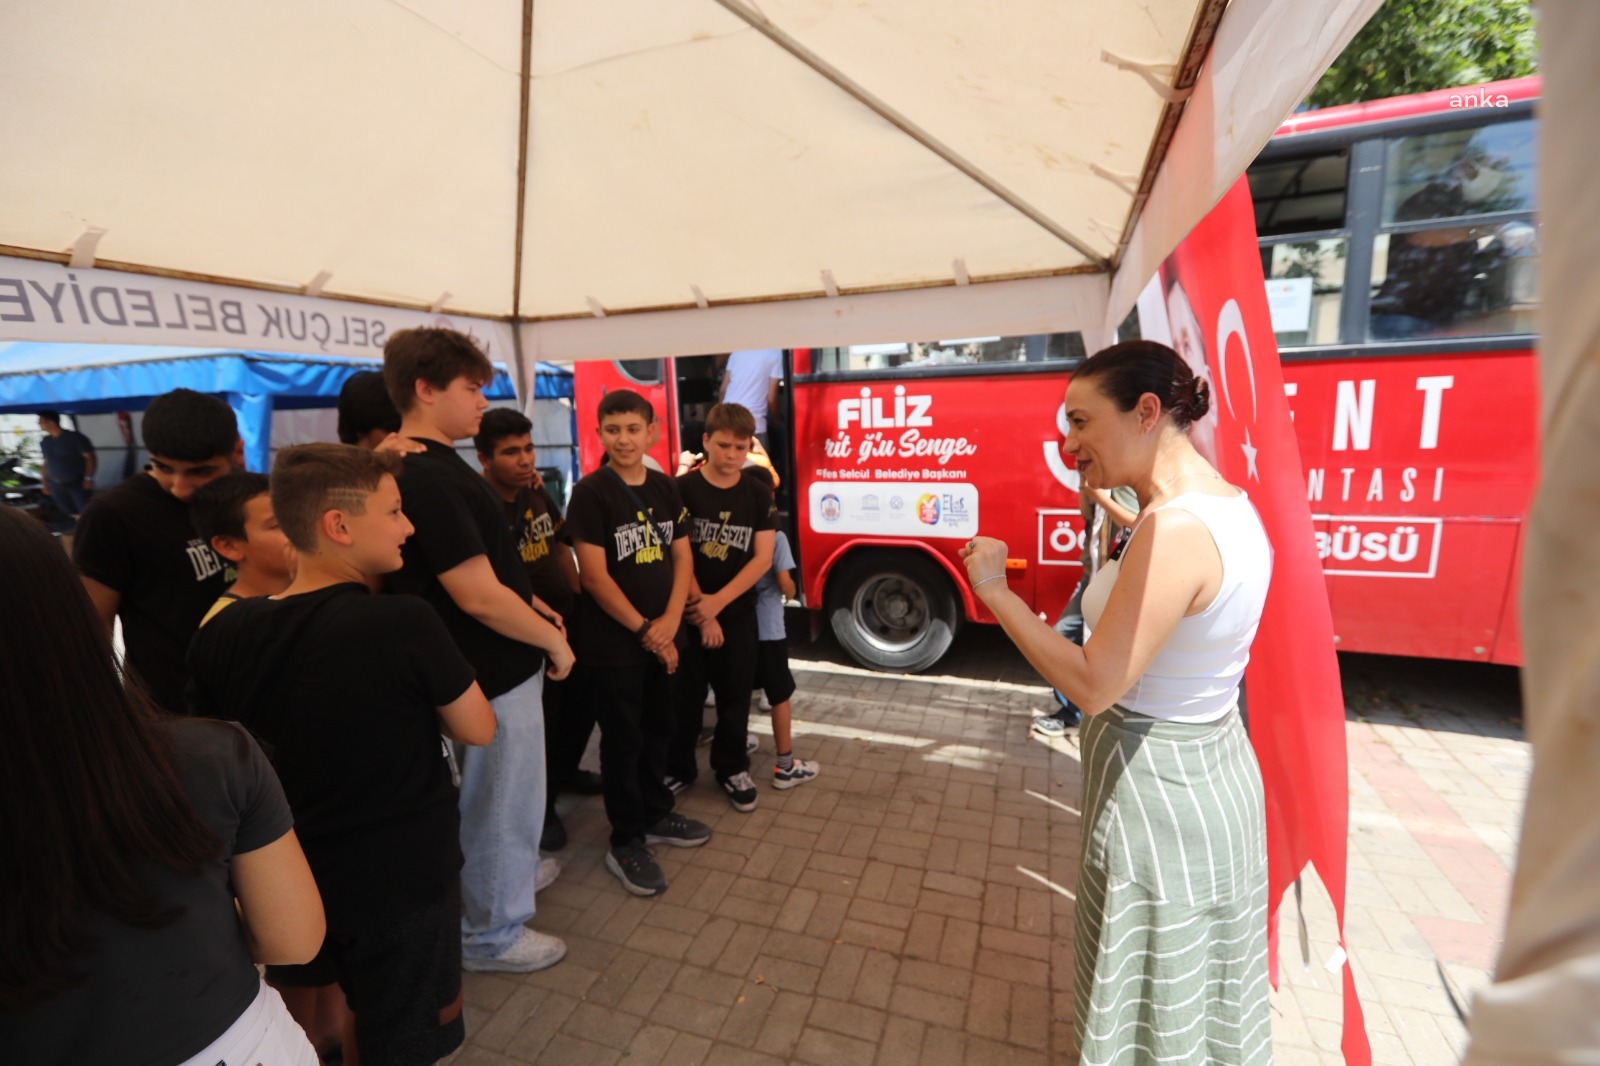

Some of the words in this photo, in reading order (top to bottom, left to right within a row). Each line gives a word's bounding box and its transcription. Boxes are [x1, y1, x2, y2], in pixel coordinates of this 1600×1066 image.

[837, 384, 934, 430] FİLİZ
[1284, 374, 1455, 451] NT
[874, 468, 920, 481] Belediye
[922, 468, 967, 481] Başkanı
[1307, 466, 1445, 503] NTASI
[1049, 520, 1086, 553] Ö
